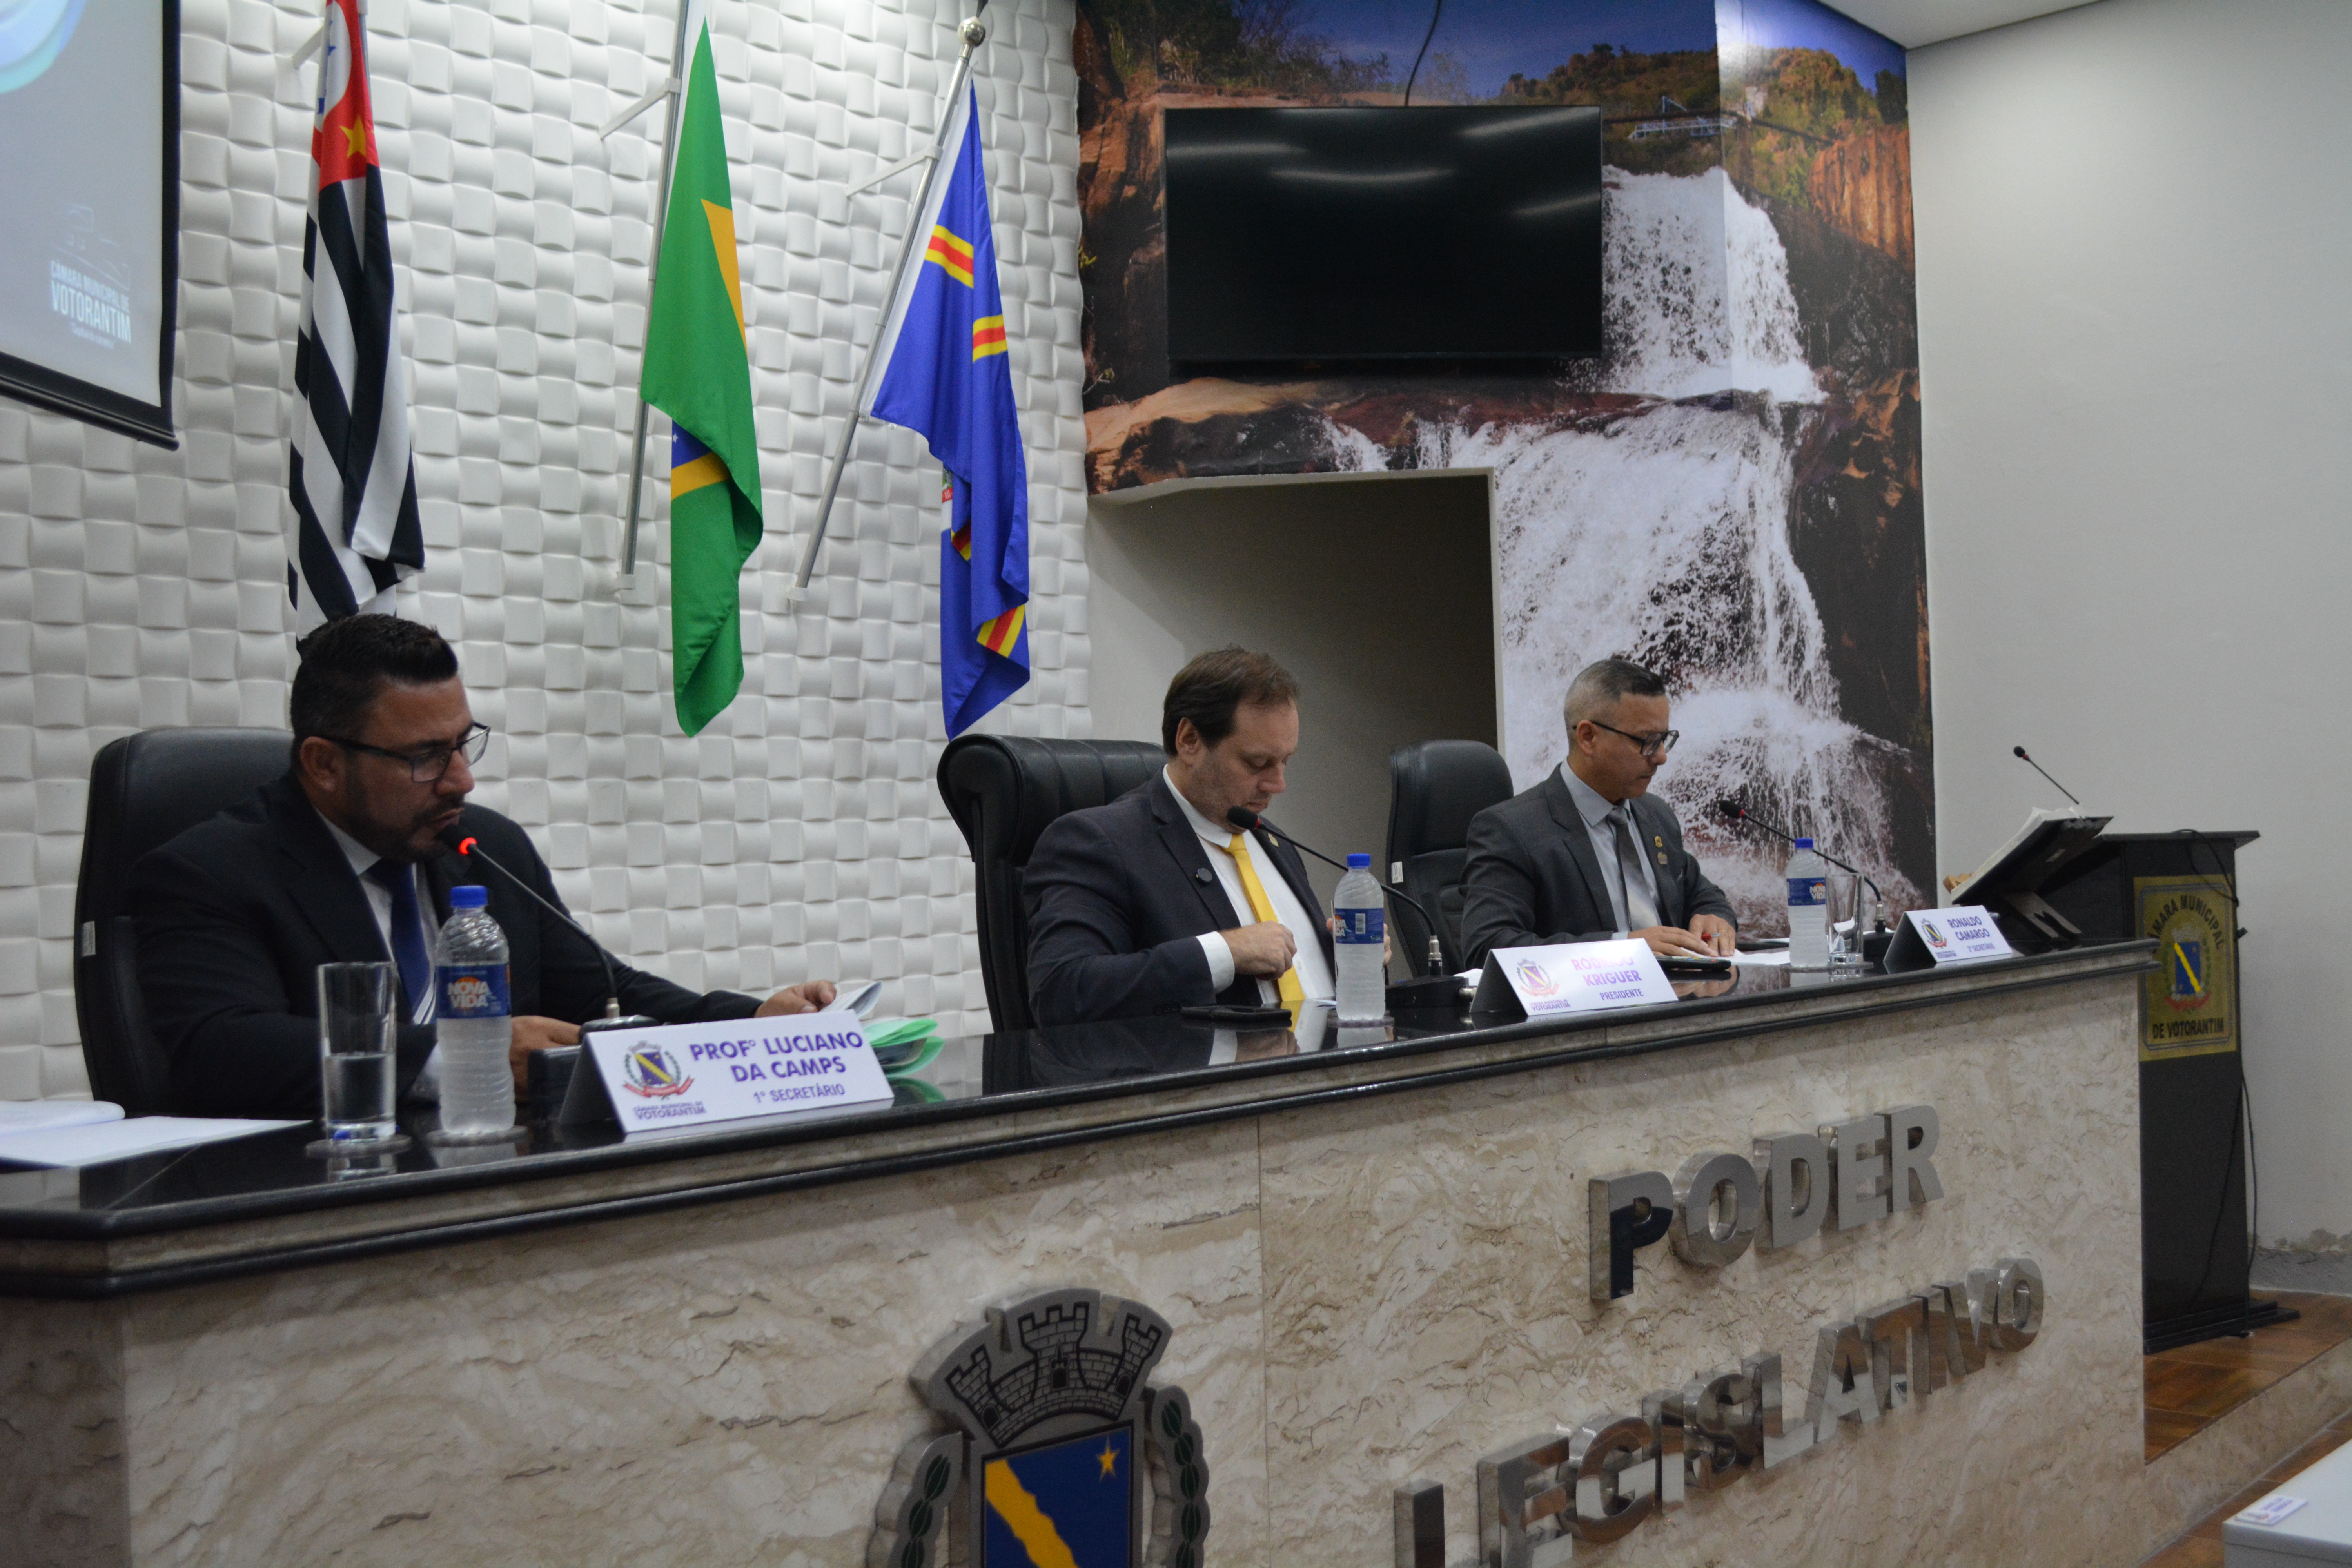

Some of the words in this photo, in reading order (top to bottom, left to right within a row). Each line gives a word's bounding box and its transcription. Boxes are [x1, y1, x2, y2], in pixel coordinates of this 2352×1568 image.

[52, 280, 131, 343] VOTORANTIM
[1947, 916, 1982, 928] RONALDO
[2180, 894, 2224, 951] MUNICIPAL
[1955, 928, 1990, 941] CAMARGO
[1582, 969, 1642, 986] KRIGUER
[447, 980, 490, 995] NOVA
[1599, 988, 1644, 1000] PRESIDENTE
[450, 995, 489, 1008] VIDA
[1531, 1002, 1571, 1011] VOTORANTIM
[2153, 1023, 2165, 1039] DE
[2167, 1017, 2224, 1038] VOTORANTIM
[763, 1031, 863, 1055] LUCIANO
[730, 1062, 767, 1082] DA
[771, 1056, 846, 1078] CAMPS
[769, 1083, 846, 1102] SECRETÁRIO
[635, 1105, 707, 1120] VOTORANTIM
[1590, 1105, 1944, 1300] PODER
